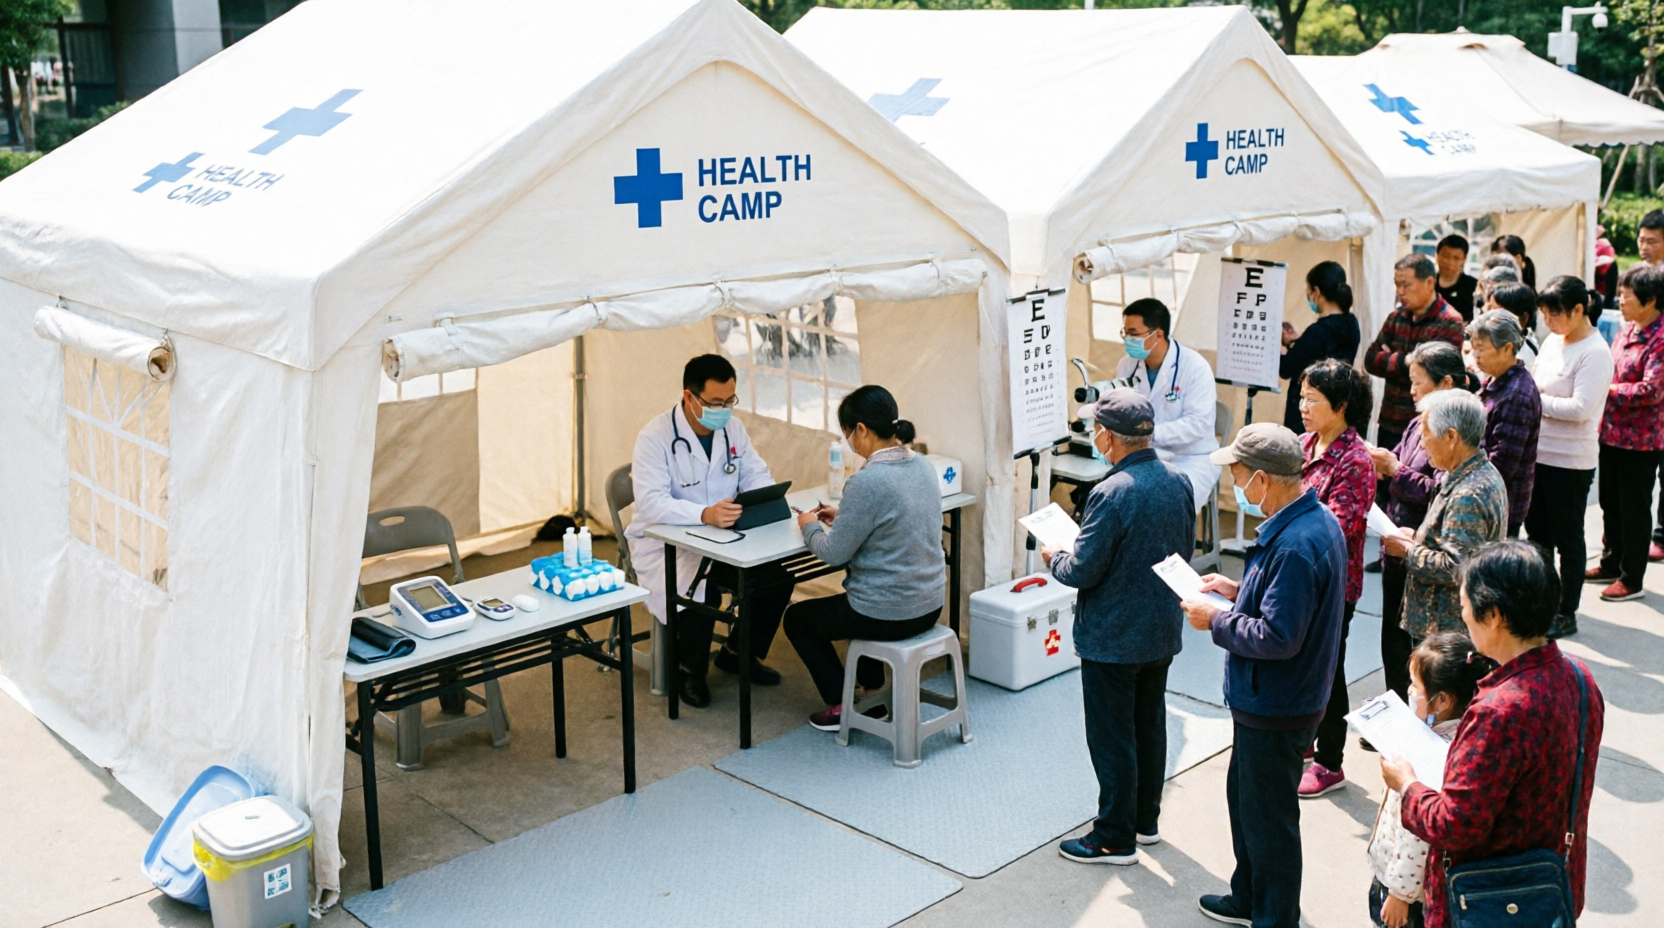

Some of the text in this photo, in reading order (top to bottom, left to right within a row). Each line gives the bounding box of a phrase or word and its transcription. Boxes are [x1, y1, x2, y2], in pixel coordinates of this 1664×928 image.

[1226, 128, 1284, 150] HEALTH
[698, 154, 811, 187] HEALTH
[1225, 153, 1268, 175] CAMP
[194, 164, 285, 191] HEALTH
[166, 183, 232, 207] CAMP
[698, 191, 782, 223] CAMP
[1245, 267, 1264, 288] E
[1031, 298, 1045, 322] E
[1236, 292, 1267, 306] F P
